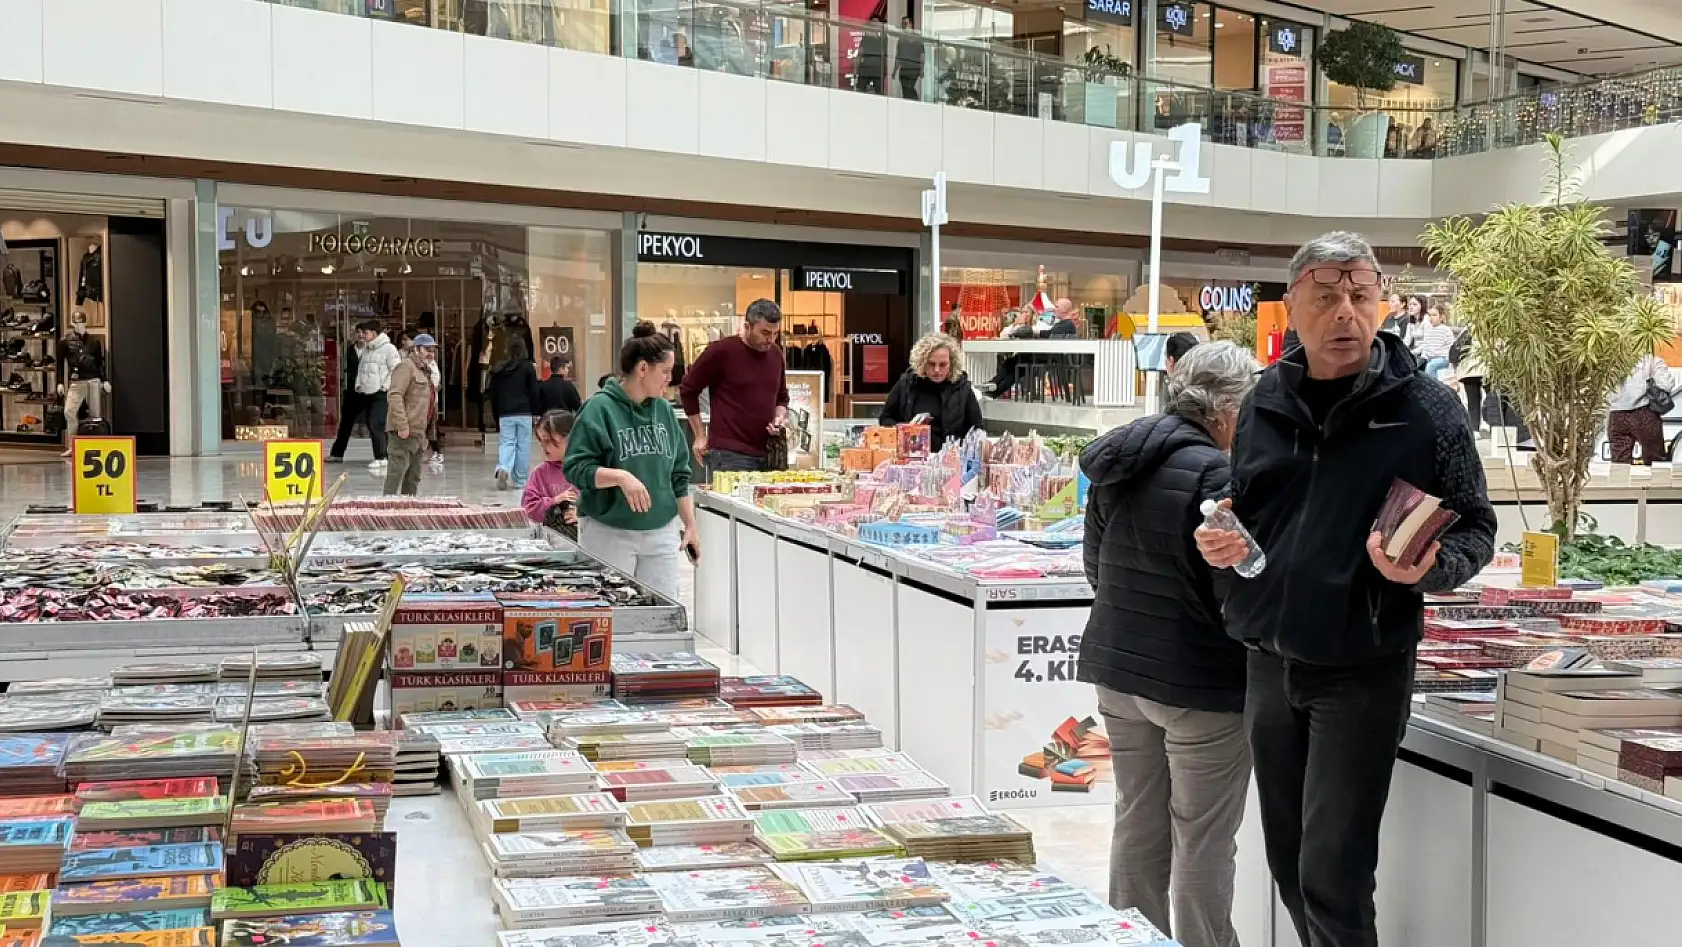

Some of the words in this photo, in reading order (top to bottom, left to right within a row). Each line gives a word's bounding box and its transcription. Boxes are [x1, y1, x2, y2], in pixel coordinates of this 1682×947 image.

[1089, 0, 1130, 16] SARAR
[1394, 63, 1414, 77] ACA
[638, 234, 704, 258] IPEKYOL
[806, 271, 852, 289] IPEKYOL
[1201, 283, 1252, 312] COLIN'S
[545, 336, 569, 354] 60
[851, 333, 883, 345] PEKYOL
[83, 450, 126, 479] 50
[274, 452, 314, 479] 50
[96, 484, 114, 496] TL
[286, 484, 303, 495] TL
[400, 611, 431, 622] TÜRK
[433, 611, 496, 621] KLASİKLERİ
[1017, 635, 1081, 653] ERAS
[1015, 660, 1043, 682] 4.
[1048, 654, 1080, 682] Kİ
[401, 674, 432, 685] TÜRK
[434, 673, 496, 684] KLASİKLERİ
[512, 673, 543, 684] TÜRK
[545, 672, 605, 683] KLASİKLERİ
